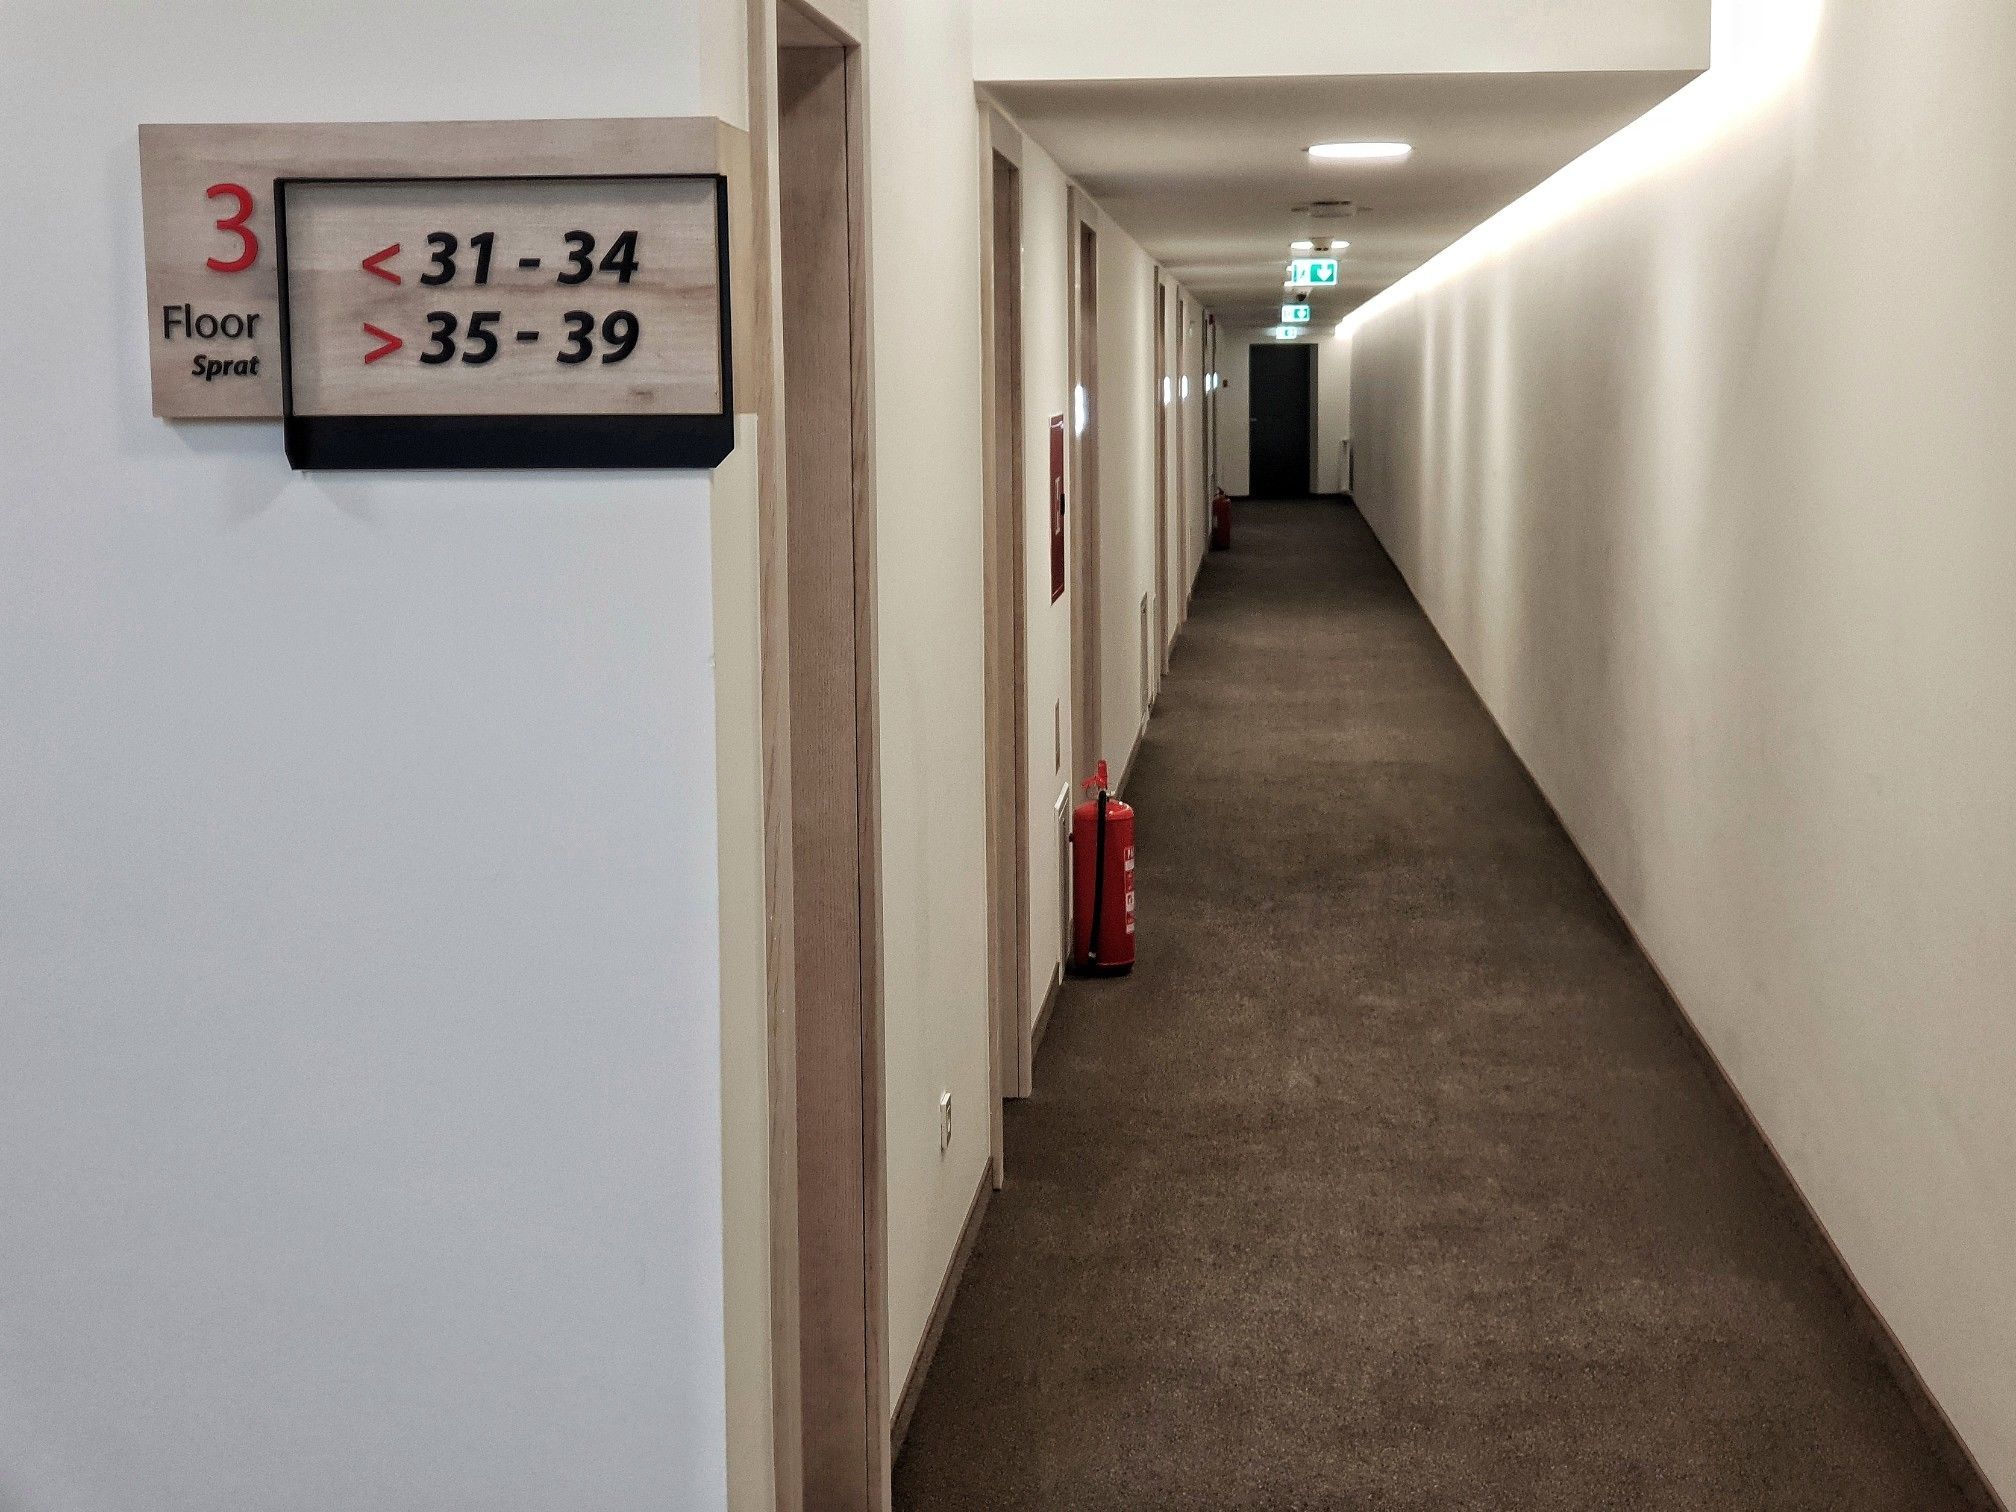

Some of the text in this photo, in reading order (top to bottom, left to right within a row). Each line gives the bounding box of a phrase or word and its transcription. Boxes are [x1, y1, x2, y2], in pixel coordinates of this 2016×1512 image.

[206, 182, 259, 273] 3
[419, 230, 496, 289] 31
[556, 229, 640, 288] 34
[162, 303, 262, 341] Floor
[419, 310, 502, 368] 35
[556, 309, 640, 367] 39
[191, 353, 262, 383] Sprat
